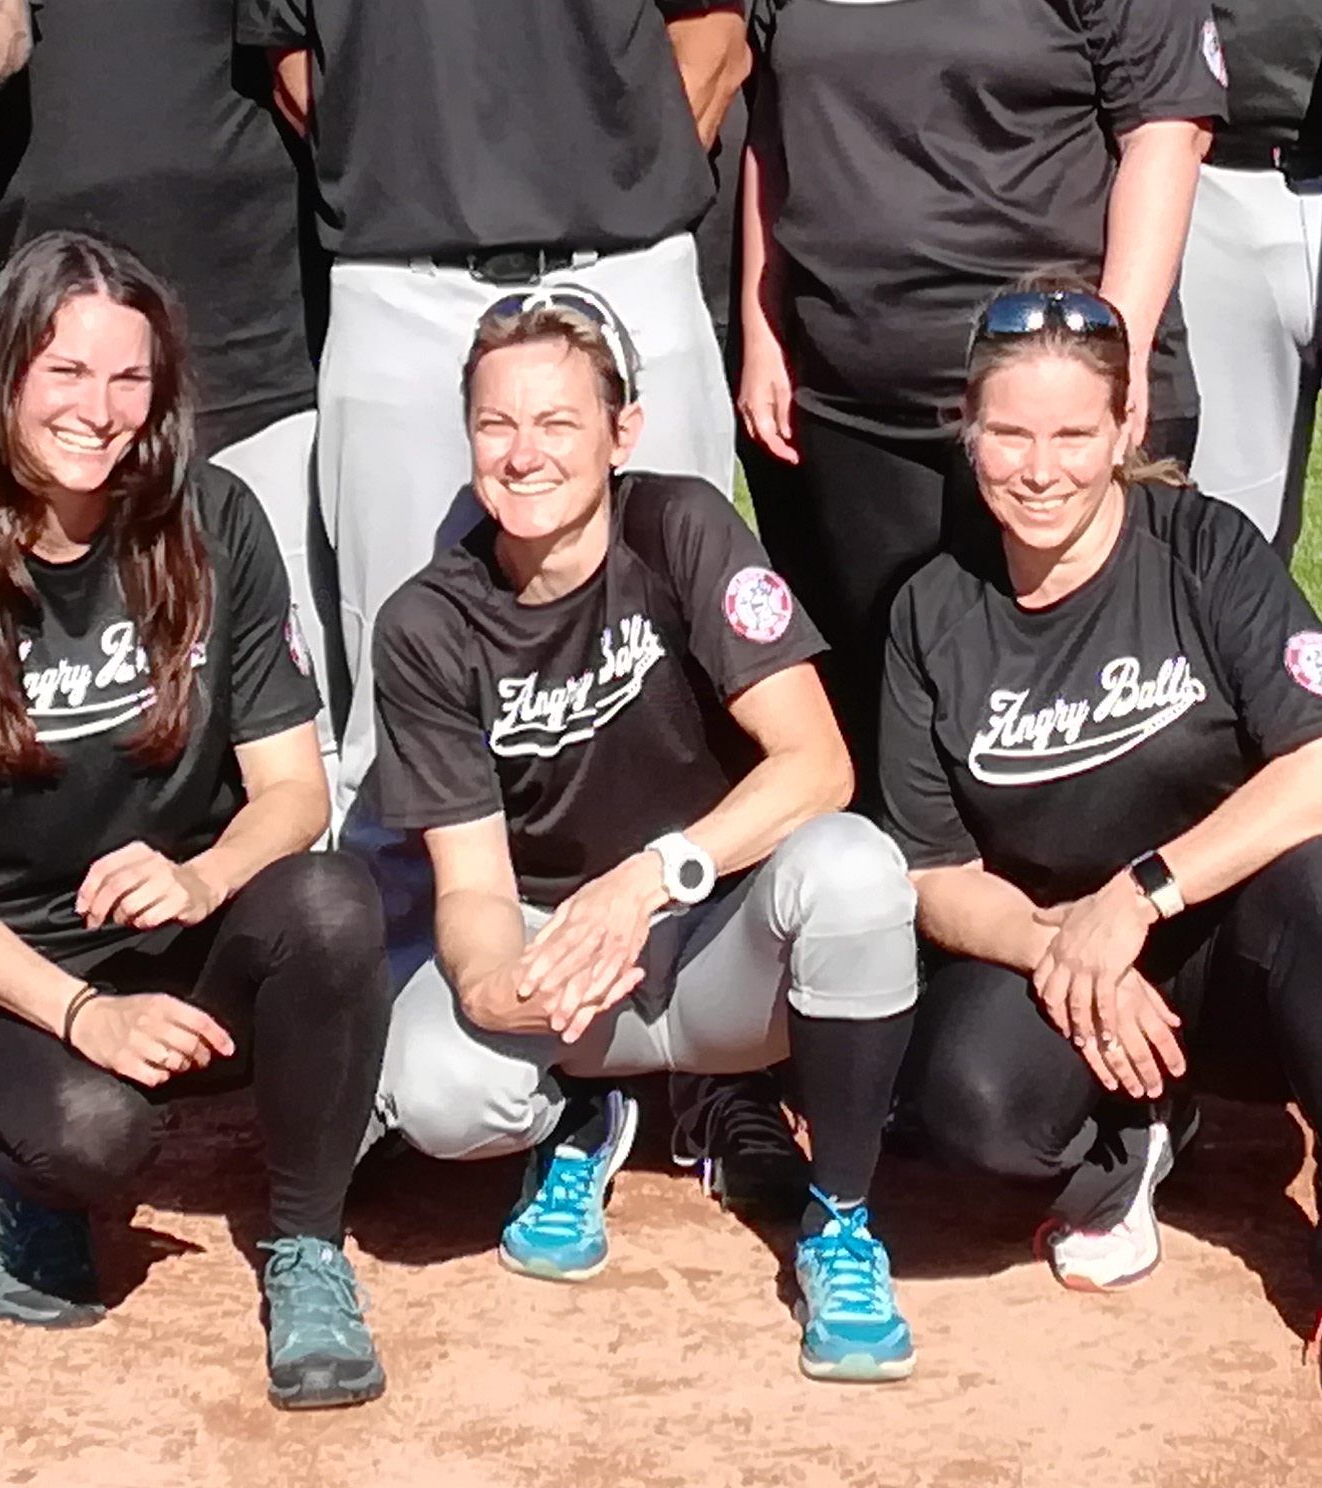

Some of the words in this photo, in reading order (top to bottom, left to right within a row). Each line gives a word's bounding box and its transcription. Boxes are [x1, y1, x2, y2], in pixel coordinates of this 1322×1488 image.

[19, 642, 92, 709] ngry
[980, 688, 1091, 749] Angry
[1094, 656, 1206, 722] Balls
